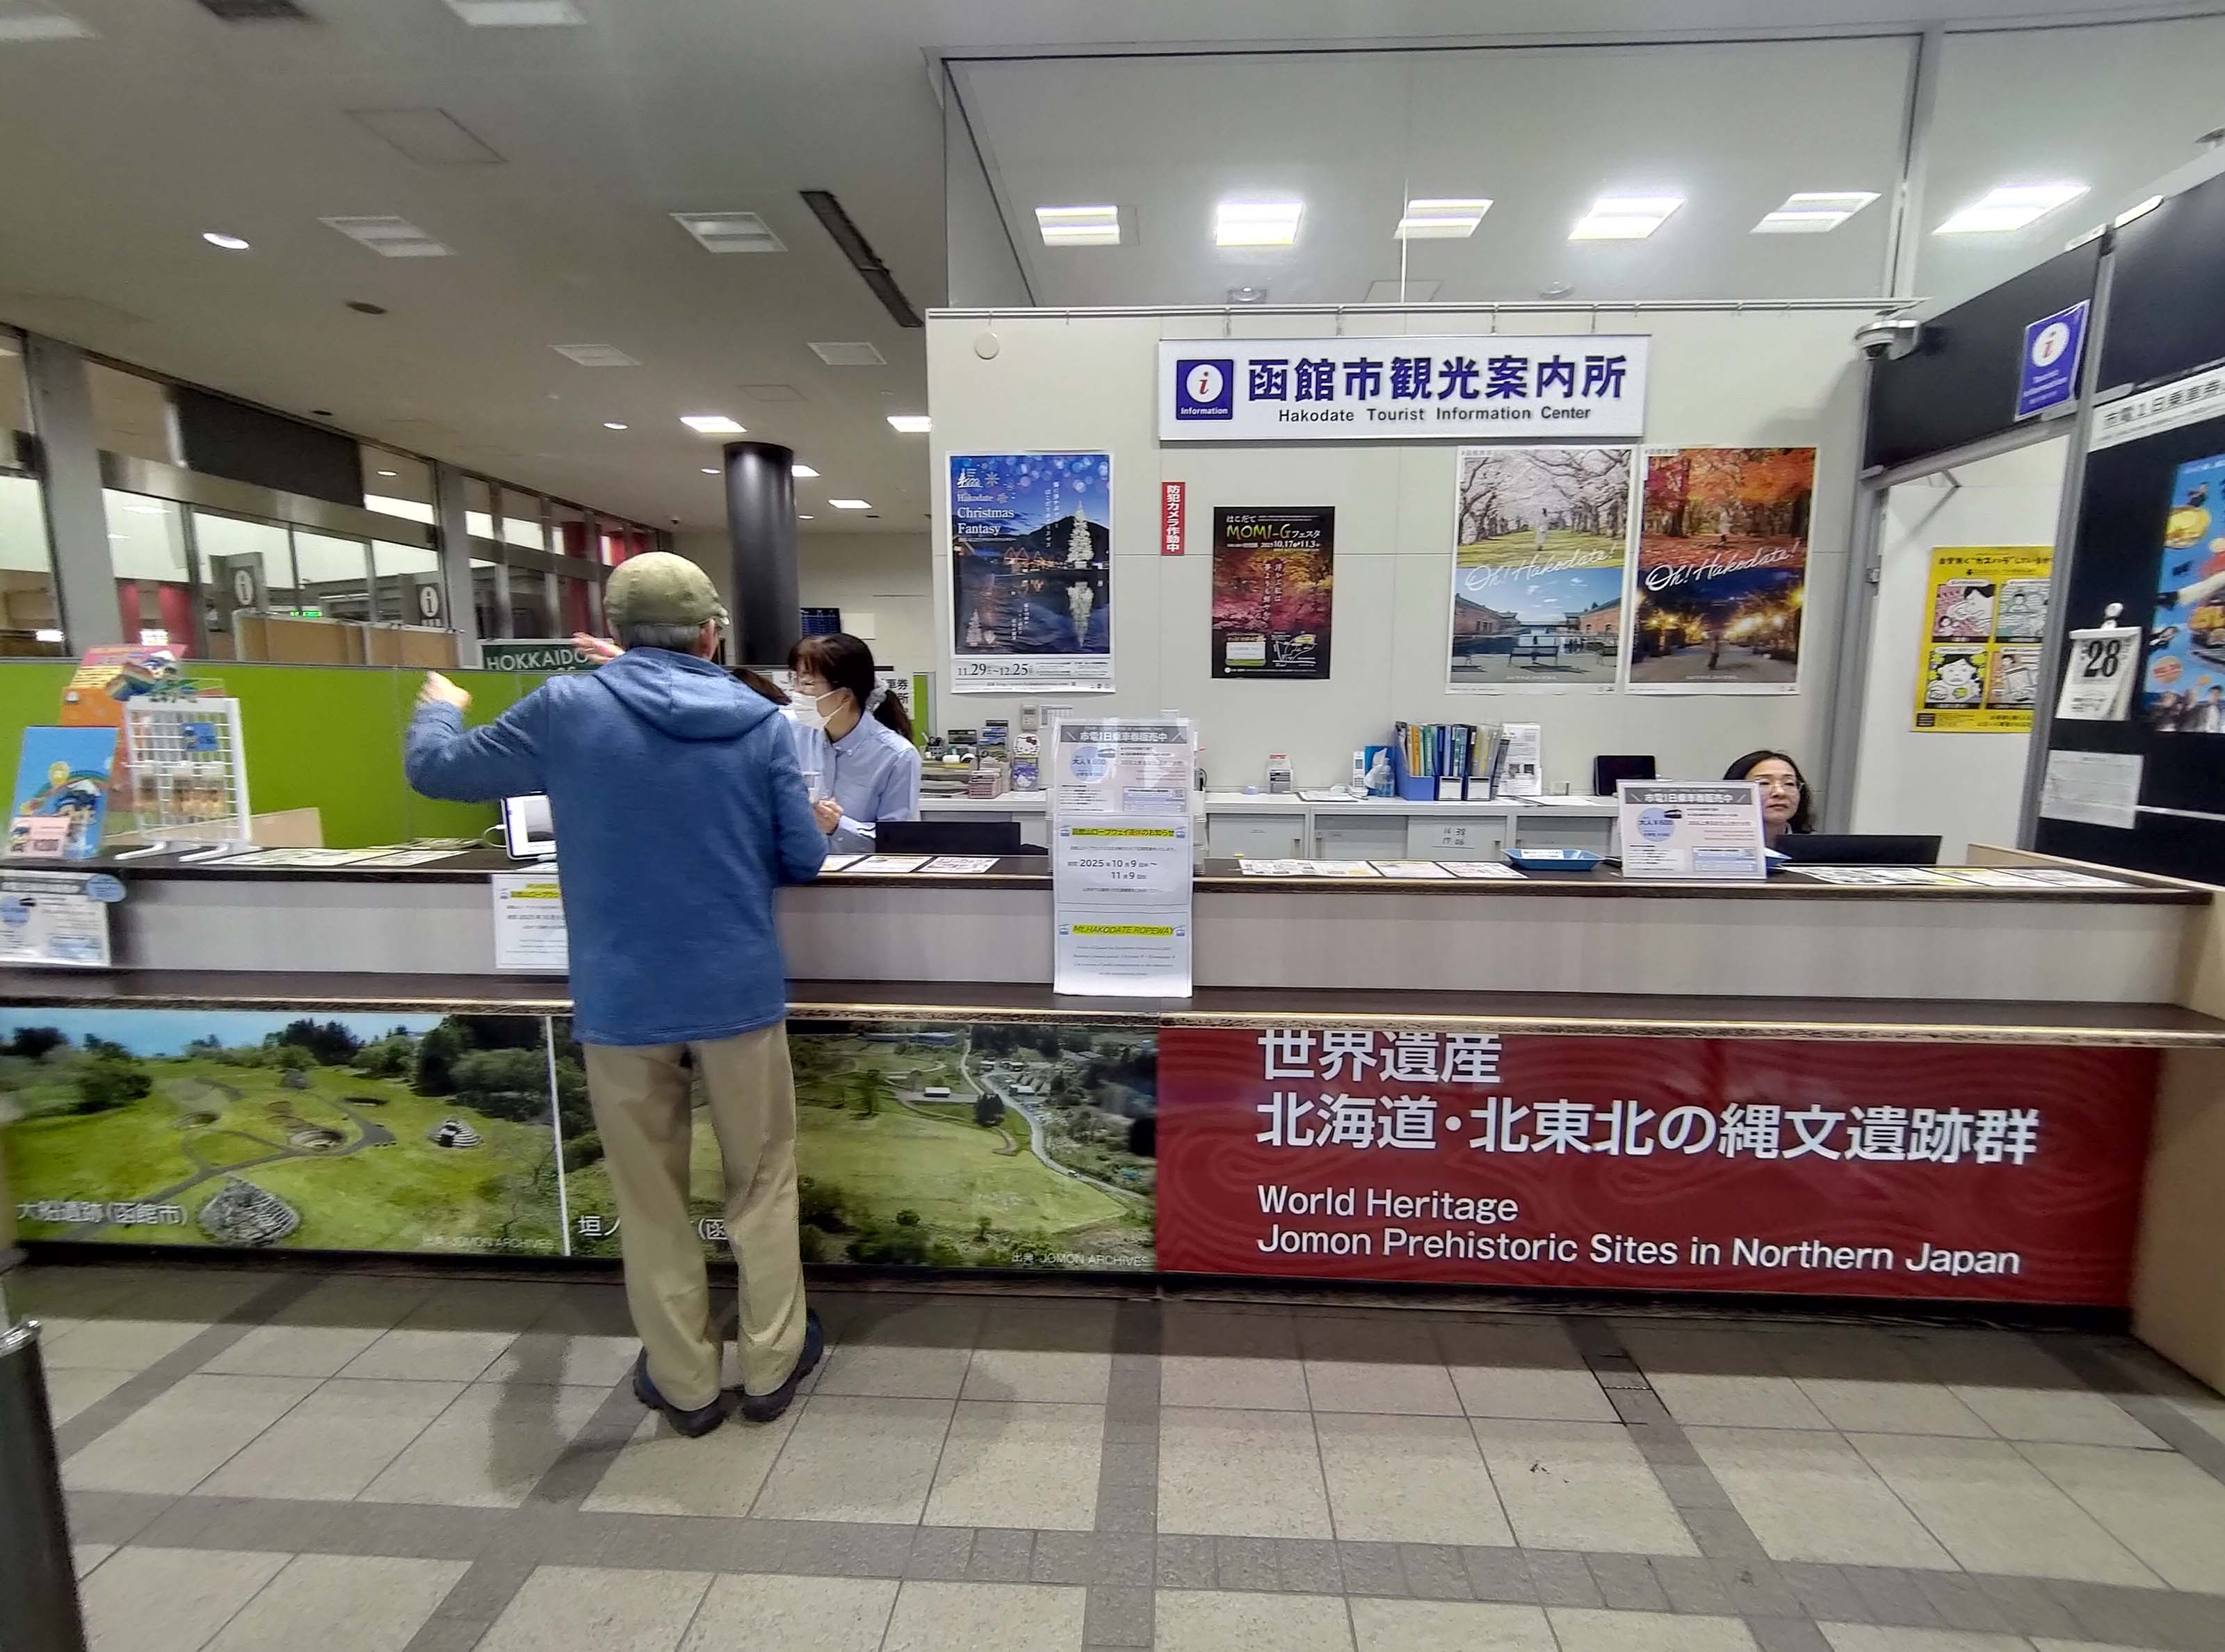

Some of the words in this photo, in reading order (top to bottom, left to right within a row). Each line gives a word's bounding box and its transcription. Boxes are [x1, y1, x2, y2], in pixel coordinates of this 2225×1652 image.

[1248, 355, 1627, 401] 函館市観光案内所
[1181, 407, 1229, 415] Information
[1279, 409, 1354, 421] Hakodate
[1366, 407, 1425, 421] Tourist
[1436, 407, 1531, 421] Information
[1541, 406, 1591, 419] Center
[2104, 380, 2225, 427] 市電1日乗車券
[957, 508, 1014, 519] Christmas
[957, 523, 1001, 535] Fantasy
[1166, 485, 1181, 552] 防犯カメラ作動中
[1645, 565, 1693, 591] Oh!
[1692, 538, 1802, 581] Hakodate!
[487, 649, 588, 671] HOKKAIDO
[2083, 640, 2121, 677] 28
[1257, 1030, 1503, 1083] 世界遺産
[1256, 1092, 2040, 1165] 北海道・北東北の縄文遺跡群
[1257, 1185, 1356, 1217] World
[1366, 1188, 1519, 1224] Heritage
[1041, 1254, 1085, 1265] JOMON
[1087, 1254, 1148, 1267] ARCHIVES
[1256, 1224, 1373, 1256] Jomon
[1383, 1227, 1579, 1263] Prehistoric
[1589, 1233, 1678, 1264] Sites
[1690, 1236, 1720, 1265] in
[1732, 1238, 1893, 1271] Northern
[1905, 1242, 2021, 1277] Japan
